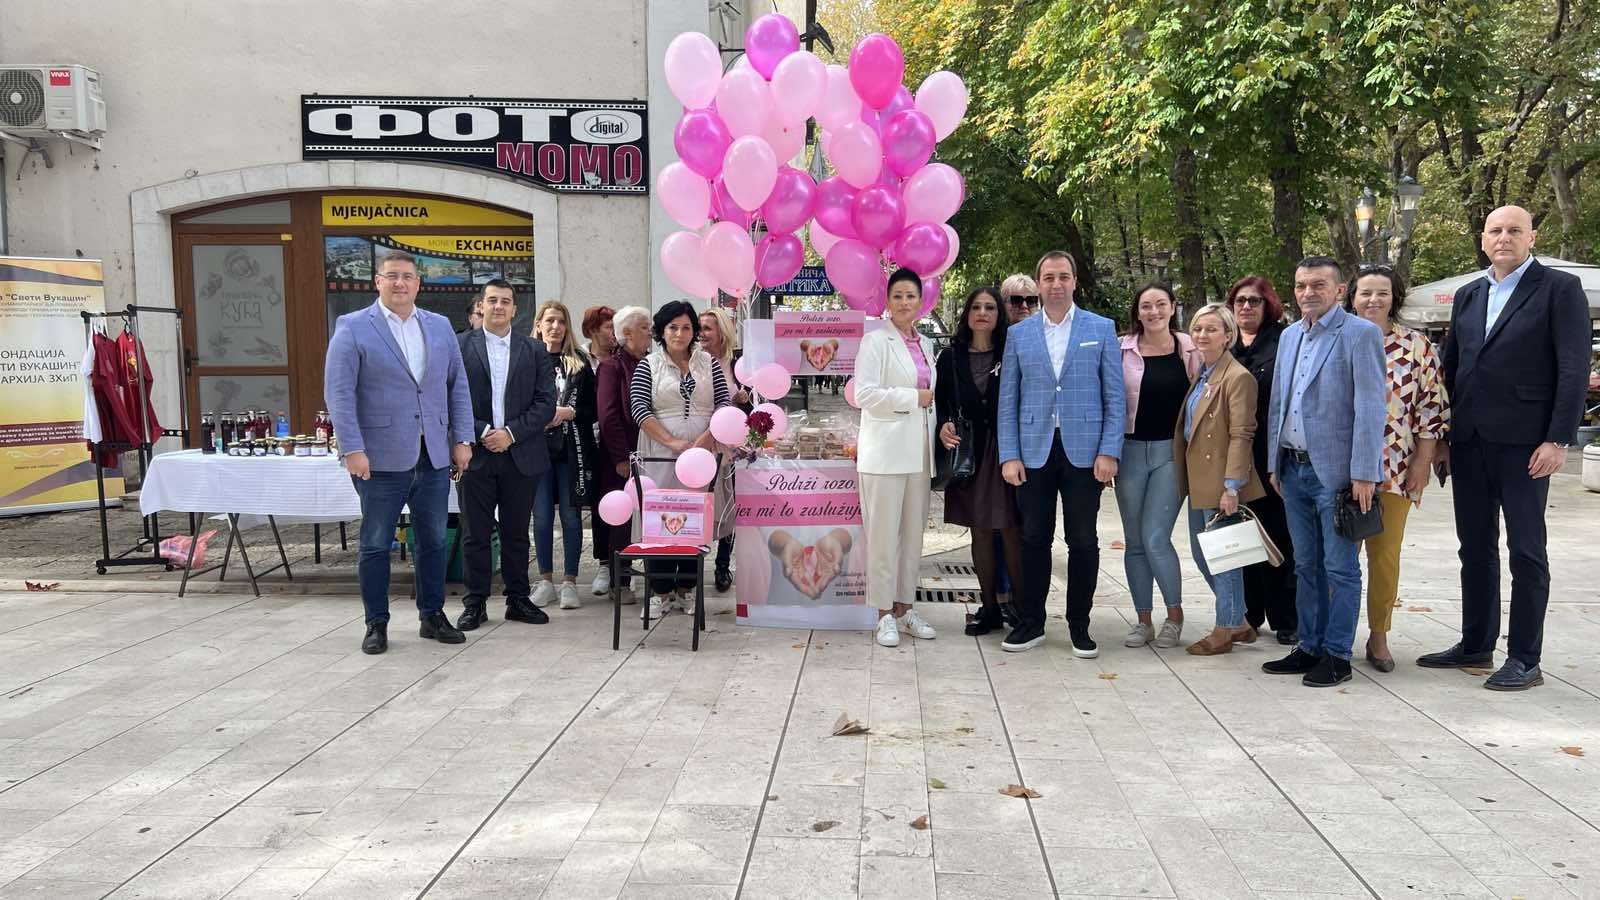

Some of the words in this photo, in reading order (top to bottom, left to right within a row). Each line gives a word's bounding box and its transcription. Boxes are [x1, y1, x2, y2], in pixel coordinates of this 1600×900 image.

[590, 116, 623, 135] digital
[331, 203, 429, 220] MJENJAČNICA
[455, 239, 533, 252] EXCHANGE
[763, 279, 831, 293] ПТИКА
[766, 472, 819, 491] Podrži
[756, 503, 776, 518] mi
[780, 501, 794, 517] to
